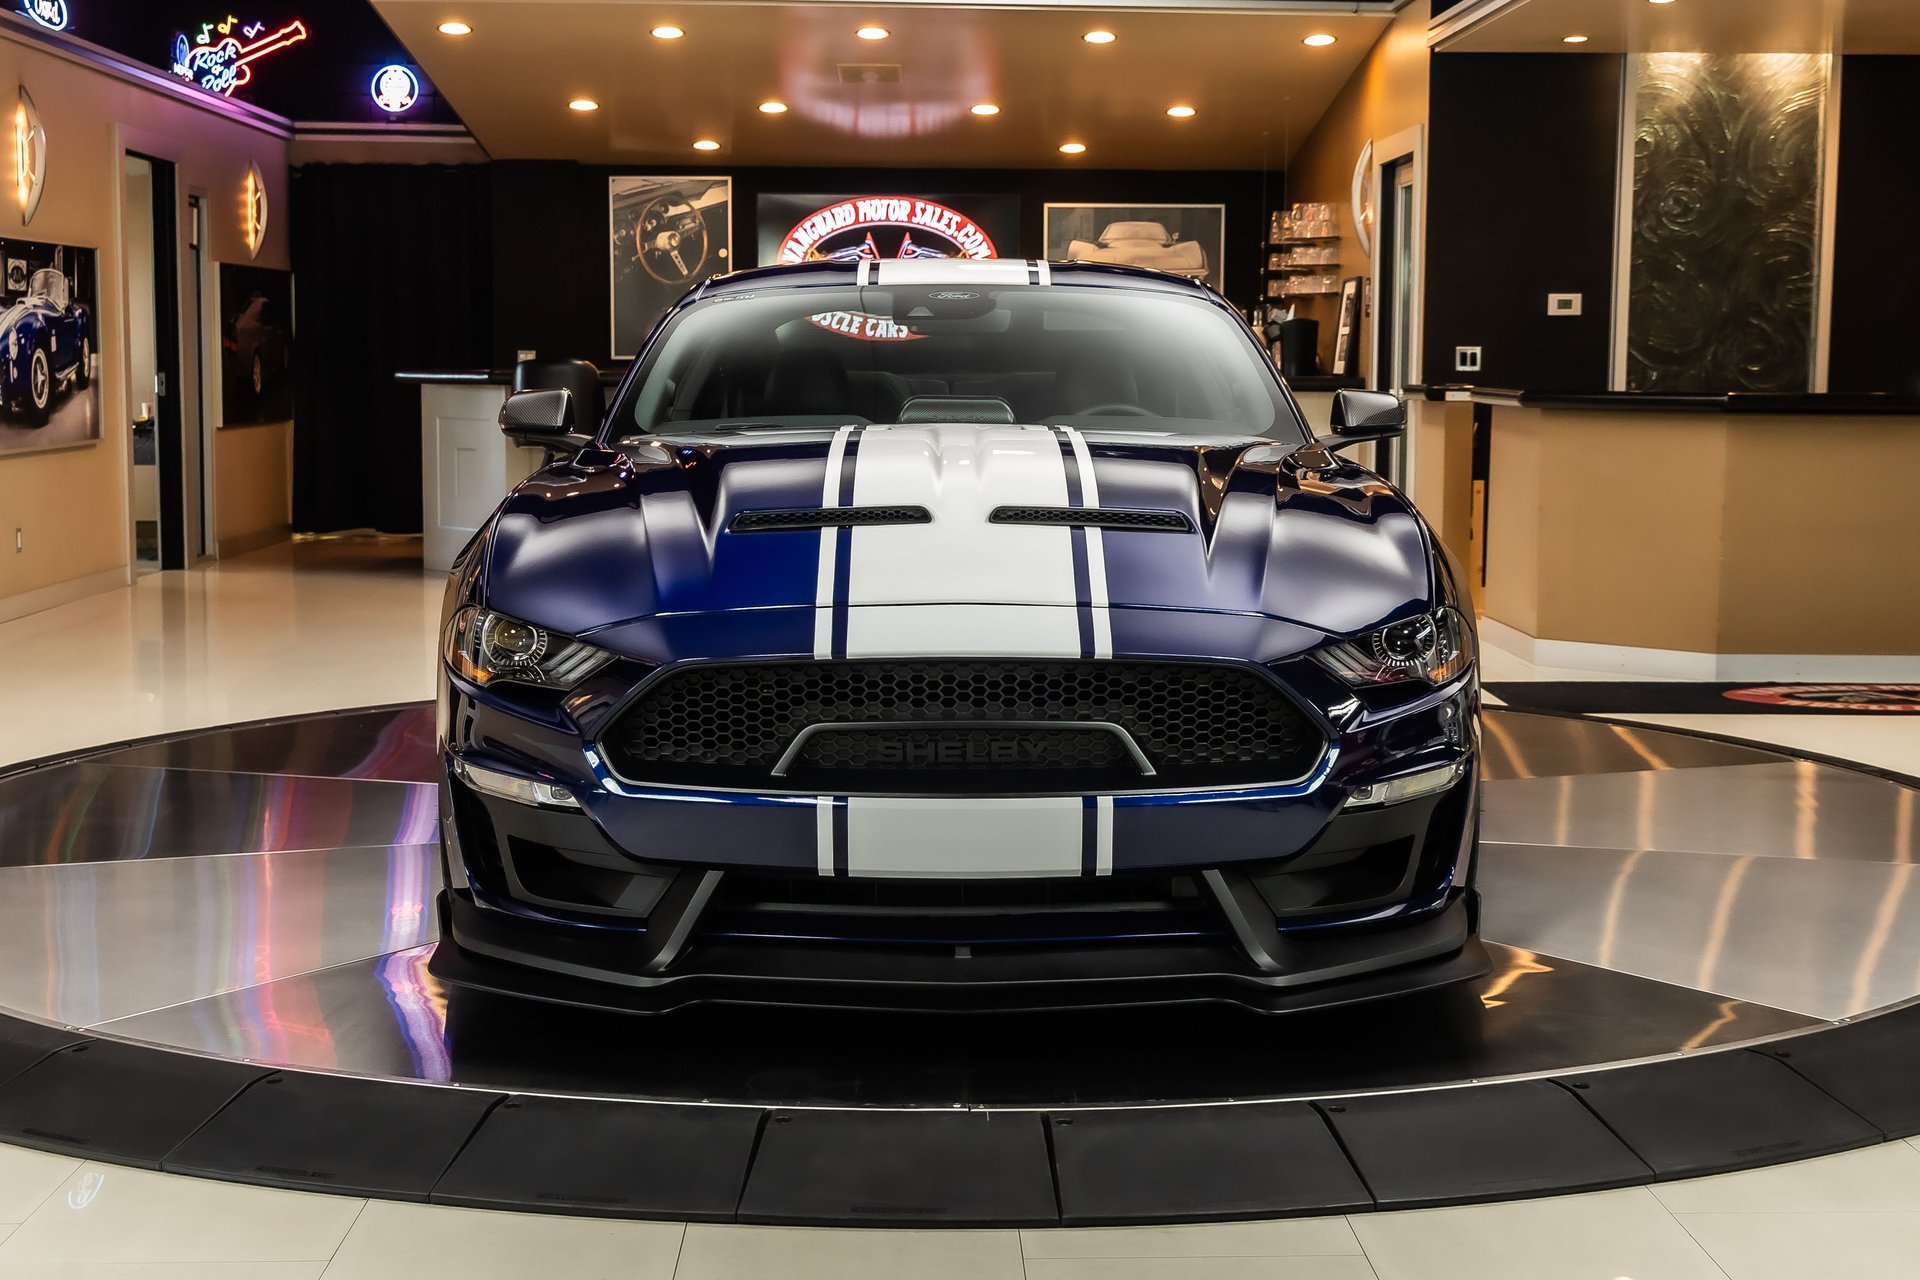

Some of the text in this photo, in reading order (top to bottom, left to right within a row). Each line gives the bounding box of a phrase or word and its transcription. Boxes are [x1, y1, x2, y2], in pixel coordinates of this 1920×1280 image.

[193, 41, 237, 71] Rock
[781, 199, 992, 263] VANGUARD MOTOR SALES.COM
[865, 318, 909, 338] CARS
[878, 741, 1049, 763] SHELBY
